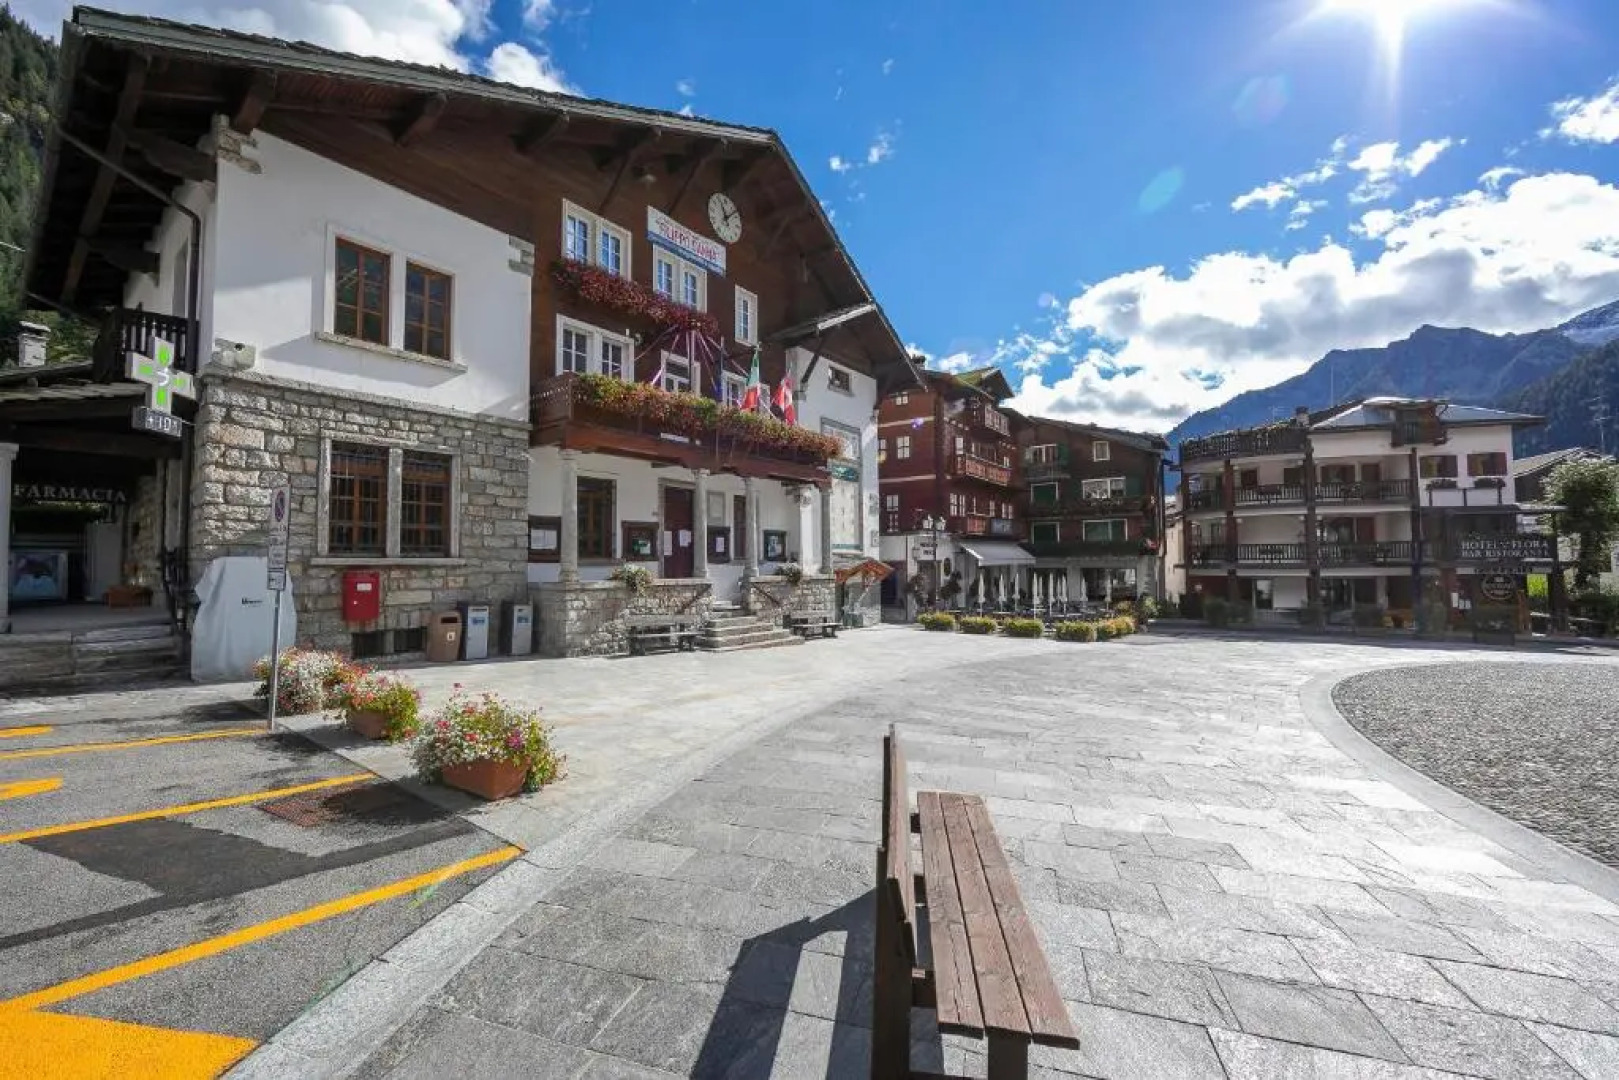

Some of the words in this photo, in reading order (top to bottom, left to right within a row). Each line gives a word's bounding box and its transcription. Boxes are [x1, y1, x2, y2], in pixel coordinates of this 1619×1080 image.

[13, 483, 127, 502] FARMACIA
[1461, 540, 1497, 550] HOTEL
[1511, 540, 1549, 549] FLORA
